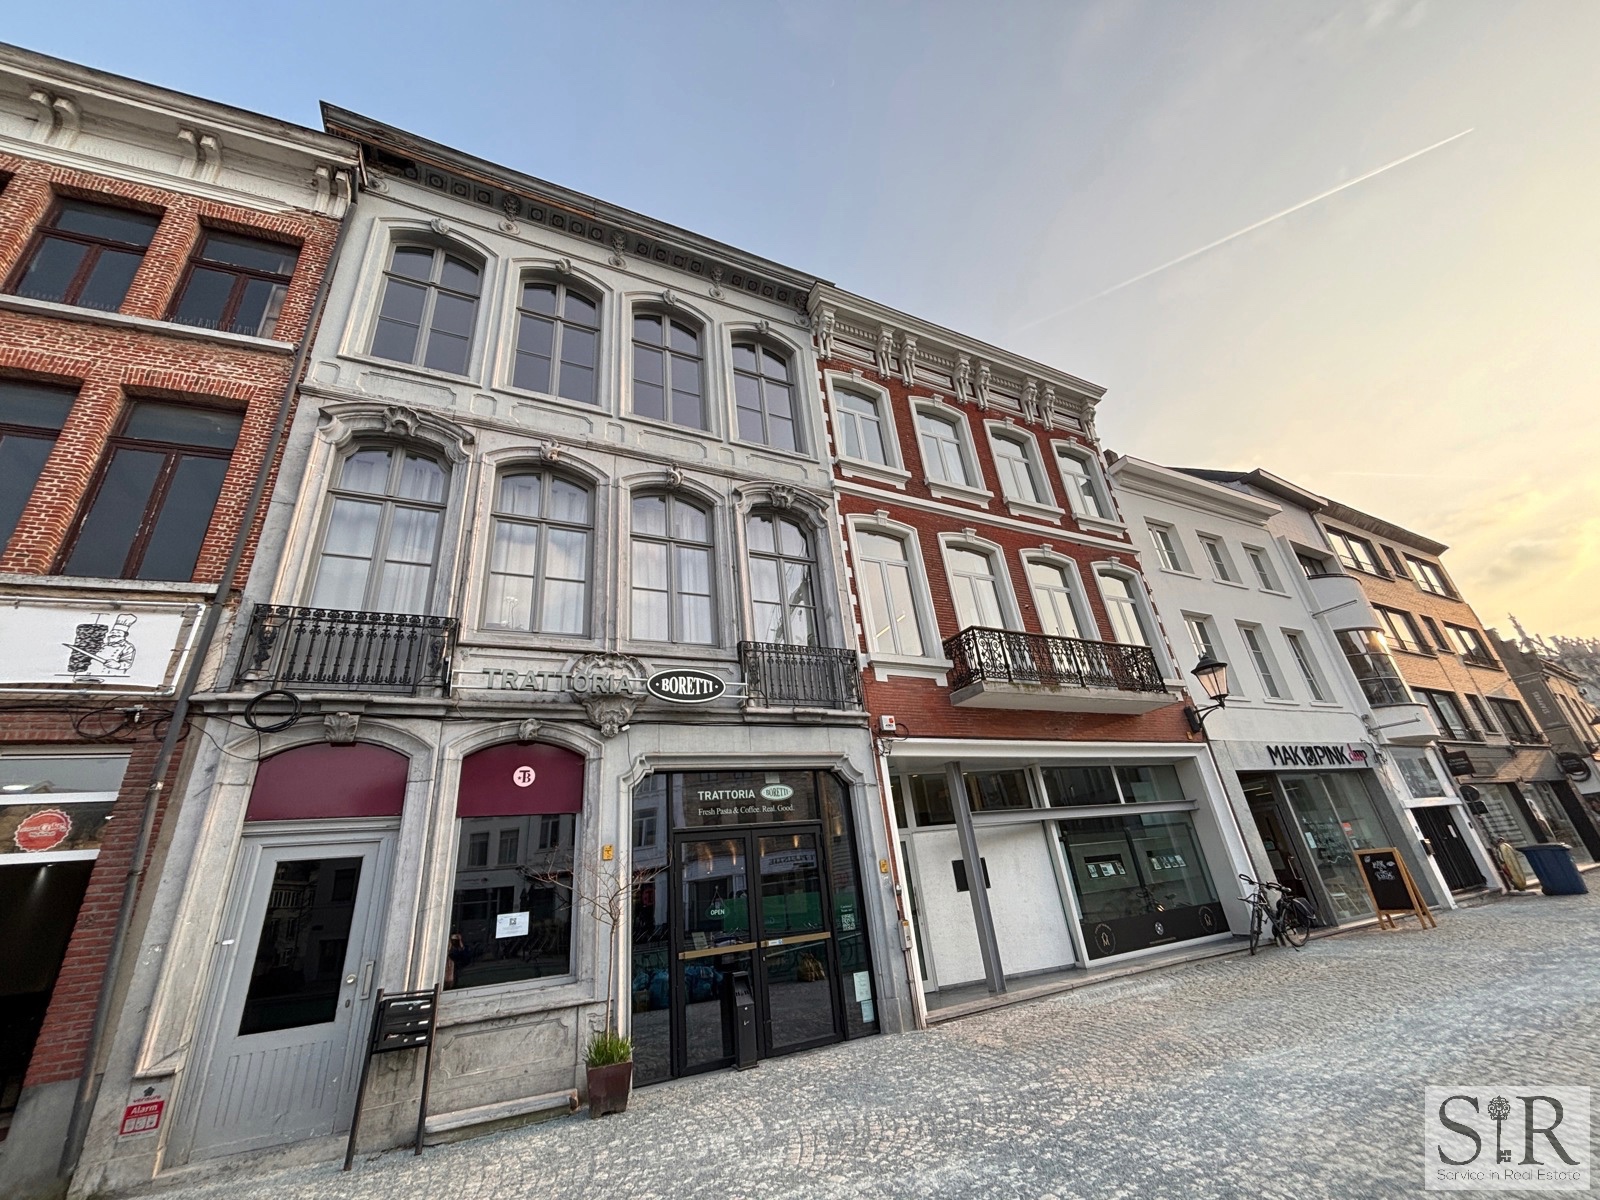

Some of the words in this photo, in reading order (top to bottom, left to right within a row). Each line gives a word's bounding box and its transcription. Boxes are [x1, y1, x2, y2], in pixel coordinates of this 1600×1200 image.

[482, 668, 633, 695] TRATTORIA
[661, 678, 714, 695] BORETTI
[697, 789, 756, 801] TRATTORIA
[765, 787, 790, 798] BORETTI
[698, 808, 716, 816] Fresh
[716, 807, 733, 815] Pasta
[733, 806, 740, 814] &
[762, 805, 777, 813] Real.
[777, 804, 795, 812] Good.
[131, 1104, 159, 1115] Alarm
